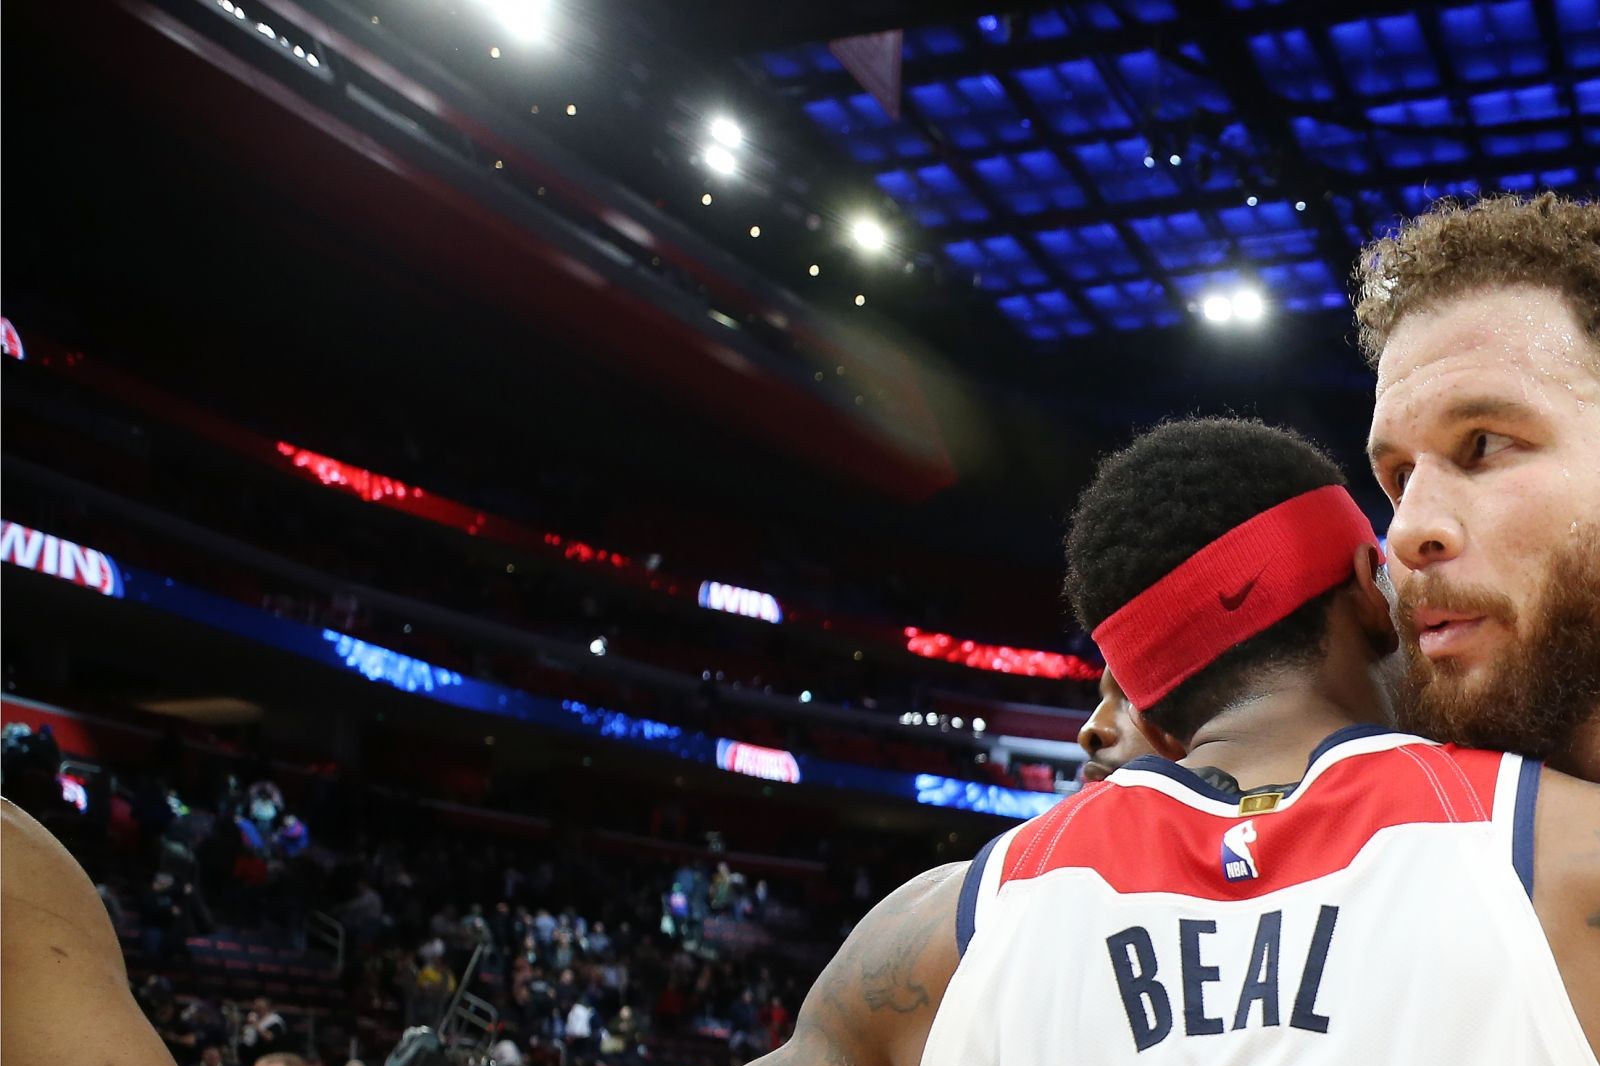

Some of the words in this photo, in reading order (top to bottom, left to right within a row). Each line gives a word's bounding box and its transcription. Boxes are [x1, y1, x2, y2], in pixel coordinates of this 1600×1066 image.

[1, 520, 101, 589] WIN
[1225, 860, 1249, 879] NBA
[1105, 904, 1340, 1053] BEAL
